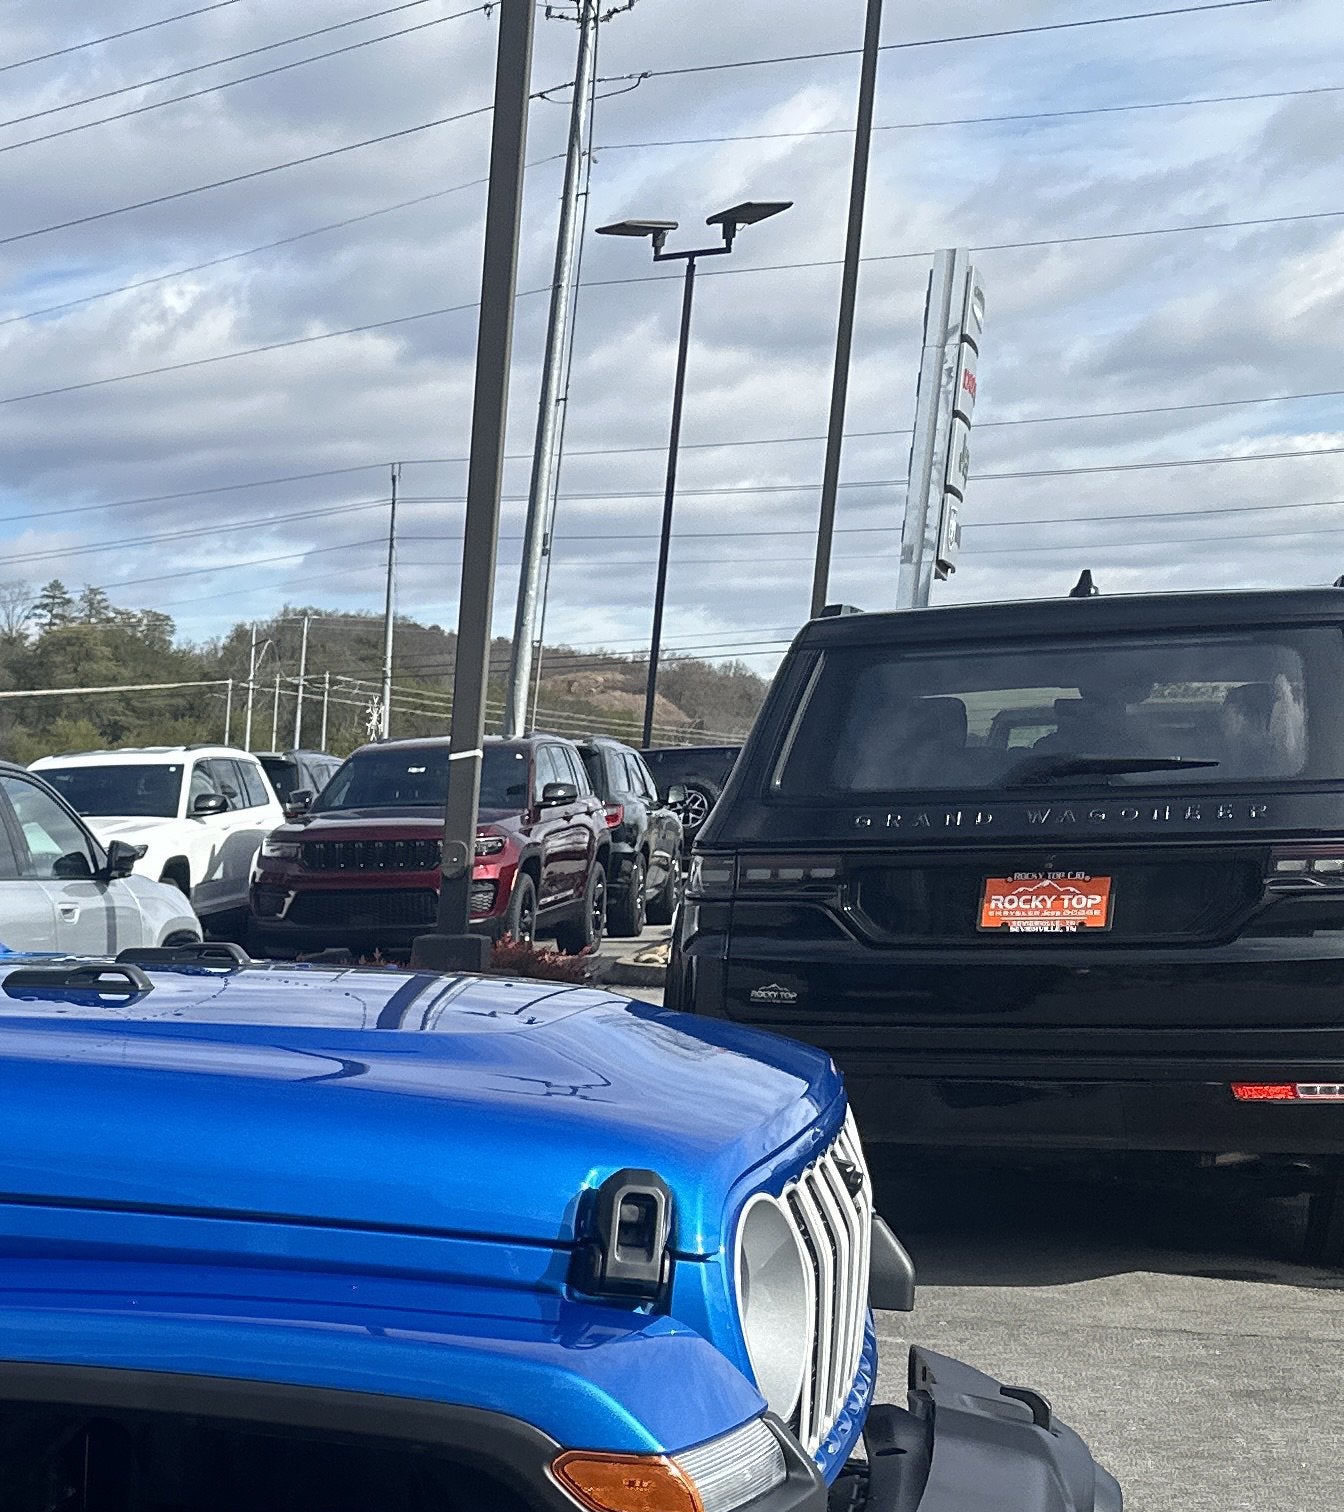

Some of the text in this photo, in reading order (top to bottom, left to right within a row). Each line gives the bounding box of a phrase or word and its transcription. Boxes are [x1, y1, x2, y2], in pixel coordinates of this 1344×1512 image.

[854, 803, 1269, 828] GRAND WAGONEER
[989, 894, 1103, 909] ROCKY TOP
